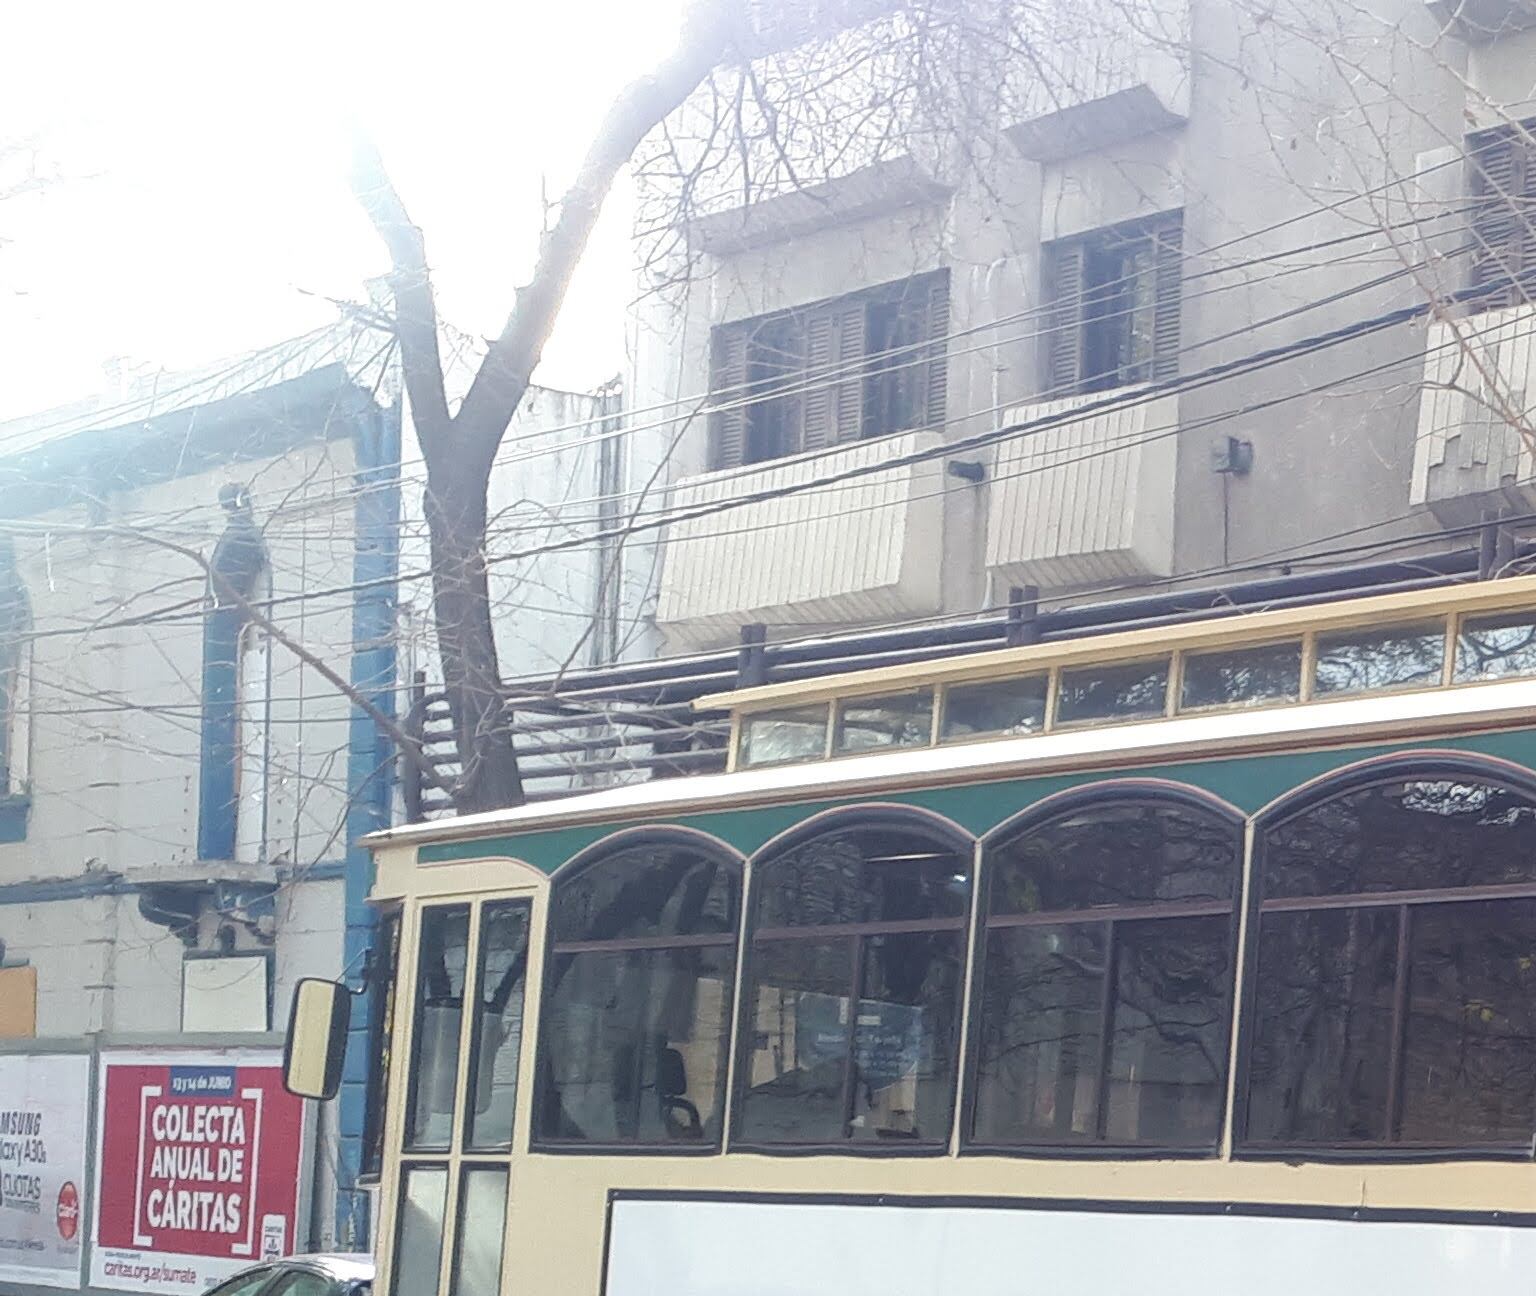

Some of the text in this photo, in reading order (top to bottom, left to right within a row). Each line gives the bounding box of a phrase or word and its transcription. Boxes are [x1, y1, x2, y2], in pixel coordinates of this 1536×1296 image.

[152, 1105, 245, 1145] COLECTA
[151, 1146, 245, 1183] ANUAL DE
[3, 1172, 41, 1200] CUOTAS
[147, 1180, 242, 1234] CÁRITAS
